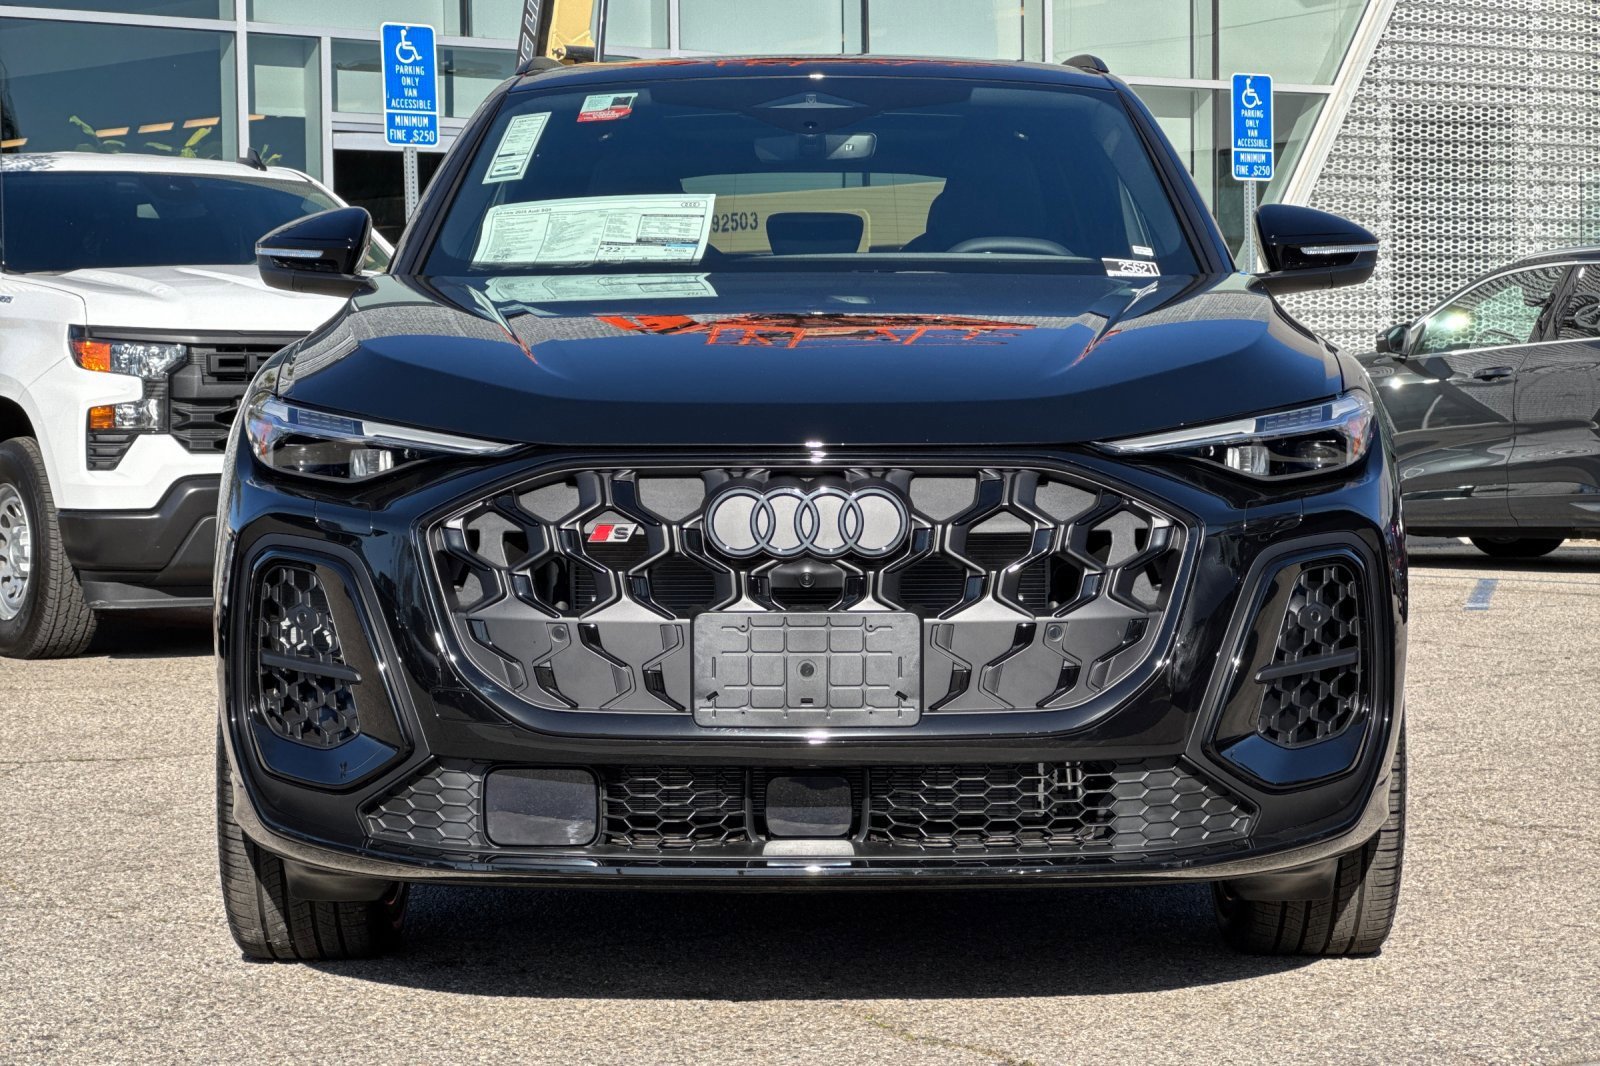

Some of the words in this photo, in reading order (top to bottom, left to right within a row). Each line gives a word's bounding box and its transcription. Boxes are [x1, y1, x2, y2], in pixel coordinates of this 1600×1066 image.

[395, 65, 424, 75] PARKING
[401, 76, 419, 86] ONLY
[404, 88, 417, 97] VAN
[391, 98, 431, 109] ACCESSIBLE
[1241, 109, 1263, 118] PARKING
[395, 115, 428, 127] MINIMUM
[1245, 119, 1259, 128] ONLY
[390, 129, 406, 141] FINE
[412, 129, 434, 143] $250
[1247, 129, 1258, 137] VAN
[1237, 138, 1268, 148] ACCESSIBLE
[1240, 153, 1266, 163] MINIMUM
[1236, 164, 1249, 175] FINE
[1253, 164, 1270, 176] $250
[712, 211, 758, 233] 92503
[613, 526, 629, 540] S
